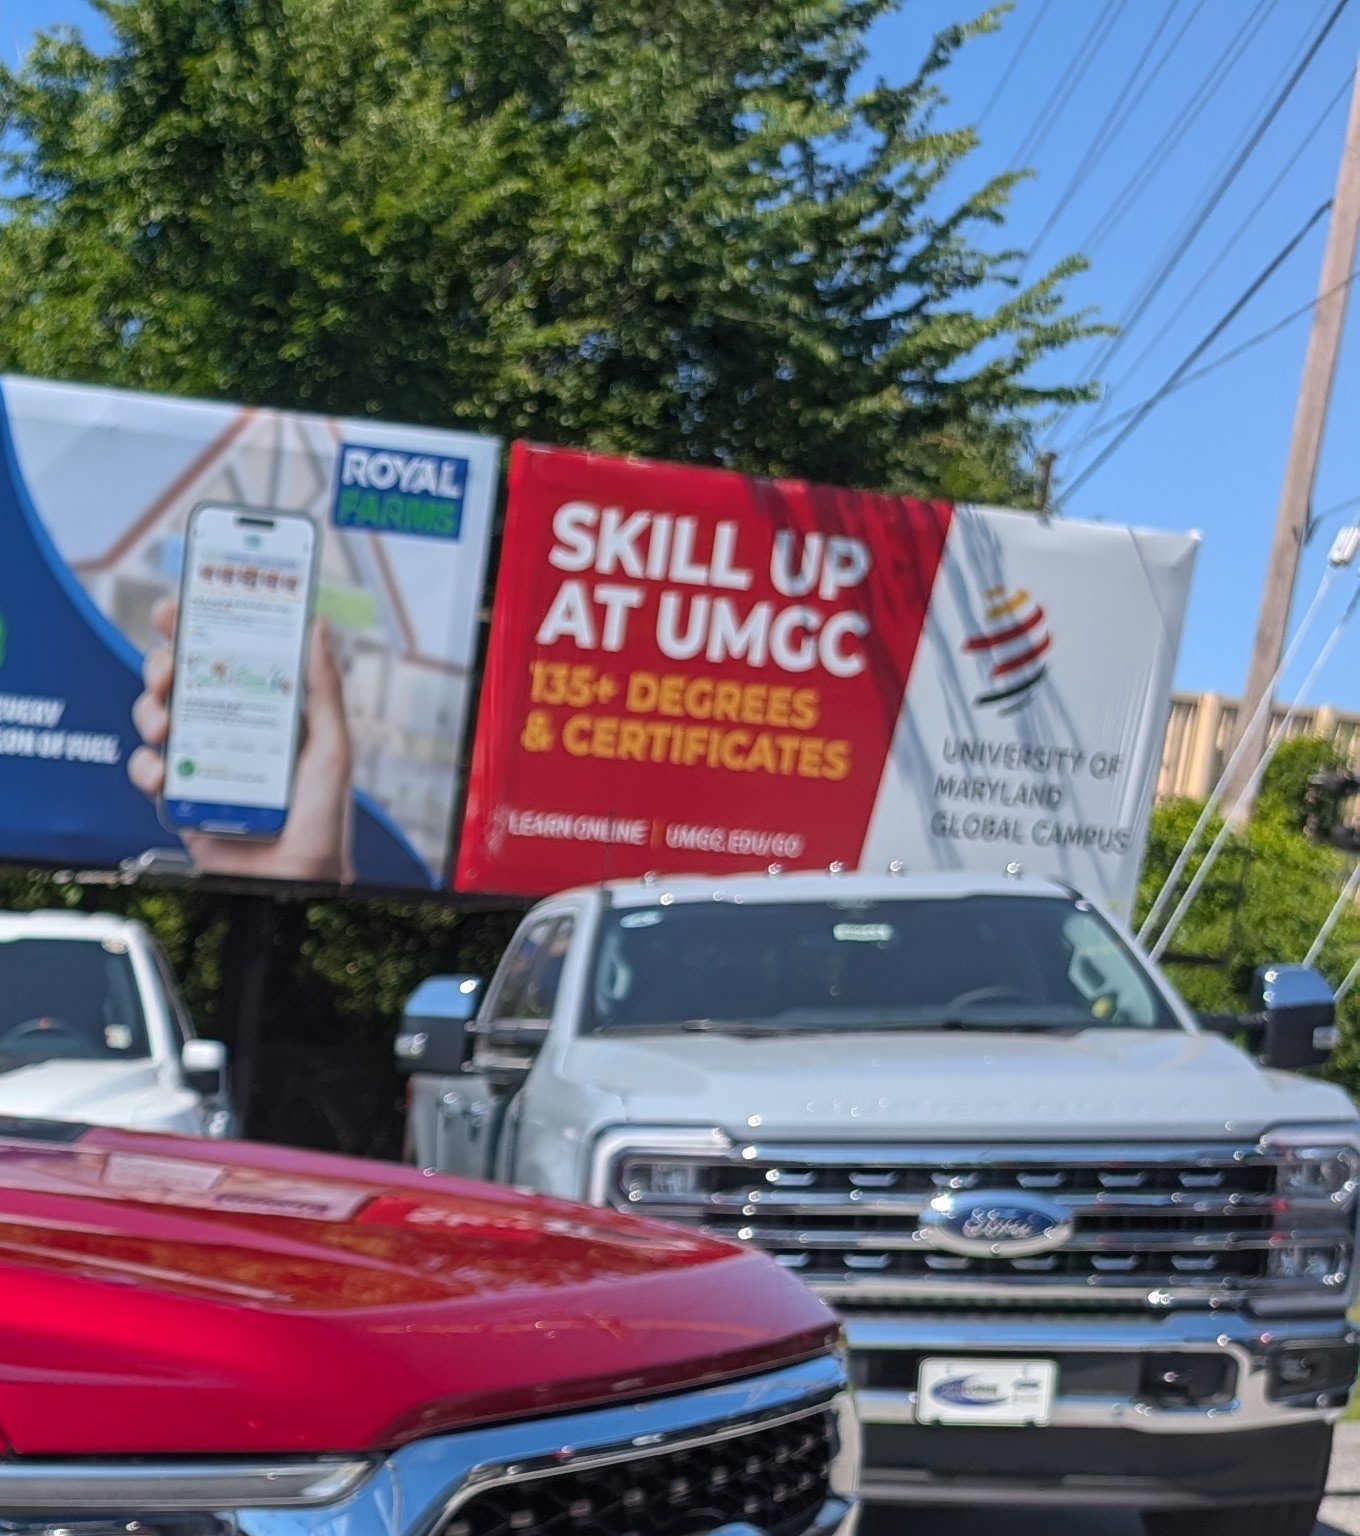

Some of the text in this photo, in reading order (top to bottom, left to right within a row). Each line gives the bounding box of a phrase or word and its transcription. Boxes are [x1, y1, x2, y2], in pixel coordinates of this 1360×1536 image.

[342, 448, 462, 499] ROYAL
[337, 489, 456, 533] FARMS
[548, 500, 873, 601] SKILL UP
[535, 578, 873, 678] AT UMGC
[530, 660, 822, 730] 135+ DEGREES
[36, 729, 65, 761] OF
[65, 731, 122, 766] FUEL
[520, 710, 853, 782] & CERTIFICATES
[942, 735, 1121, 780] UNIVERSITY OF
[933, 774, 1063, 813] MARYLAND
[508, 809, 650, 846] LEARN ONLINE
[930, 808, 1131, 856] GLOBAL CAMPUS
[962, 1207, 1036, 1240] Ford
